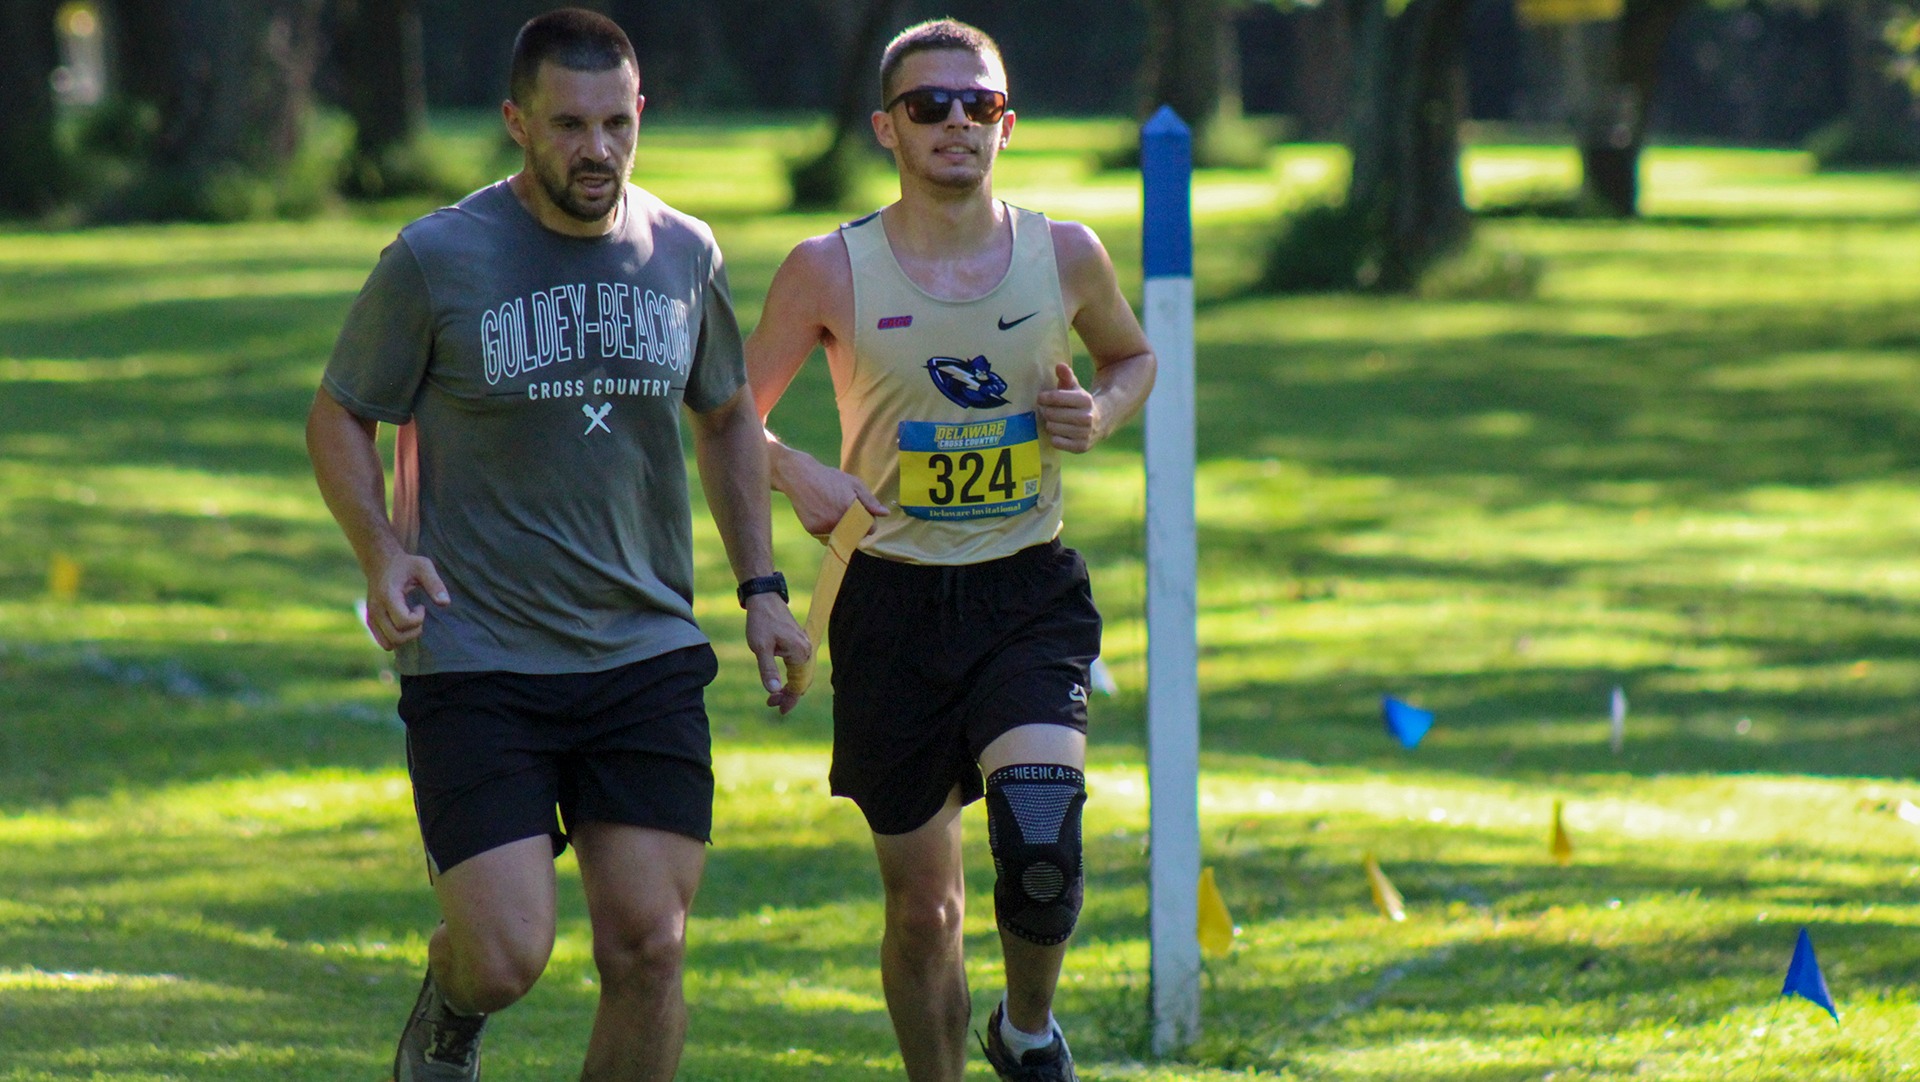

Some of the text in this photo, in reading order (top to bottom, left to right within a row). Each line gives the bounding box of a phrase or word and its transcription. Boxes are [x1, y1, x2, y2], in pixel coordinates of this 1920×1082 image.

[528, 378, 670, 400] CROSS COUNTRY
[936, 422, 1005, 440] DELAWARE
[940, 435, 998, 448] CROSS COUNTRY
[928, 448, 1016, 506] 324
[929, 502, 1021, 518] Delaware Invitational
[1014, 766, 1065, 780] NEENCA
